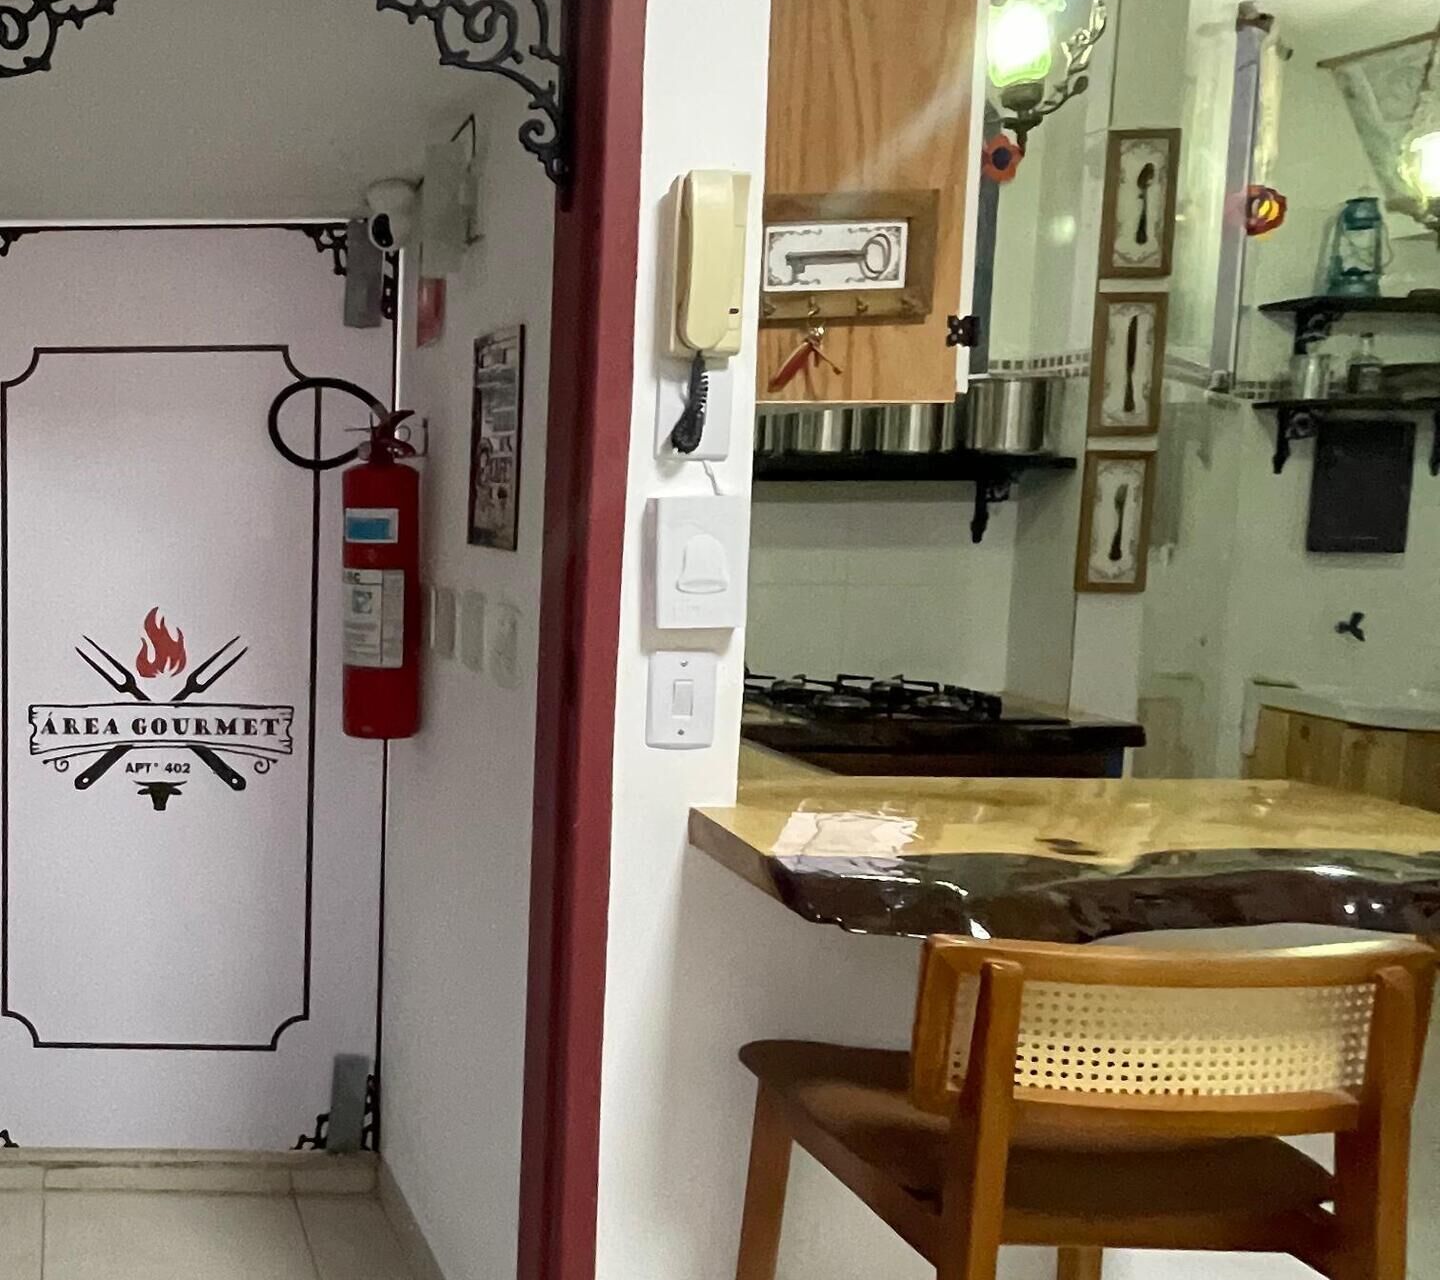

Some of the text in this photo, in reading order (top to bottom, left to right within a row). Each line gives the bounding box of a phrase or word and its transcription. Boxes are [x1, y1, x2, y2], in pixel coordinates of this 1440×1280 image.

[40, 712, 281, 738] ÁREA GOURMET
[164, 762, 192, 775] 402
